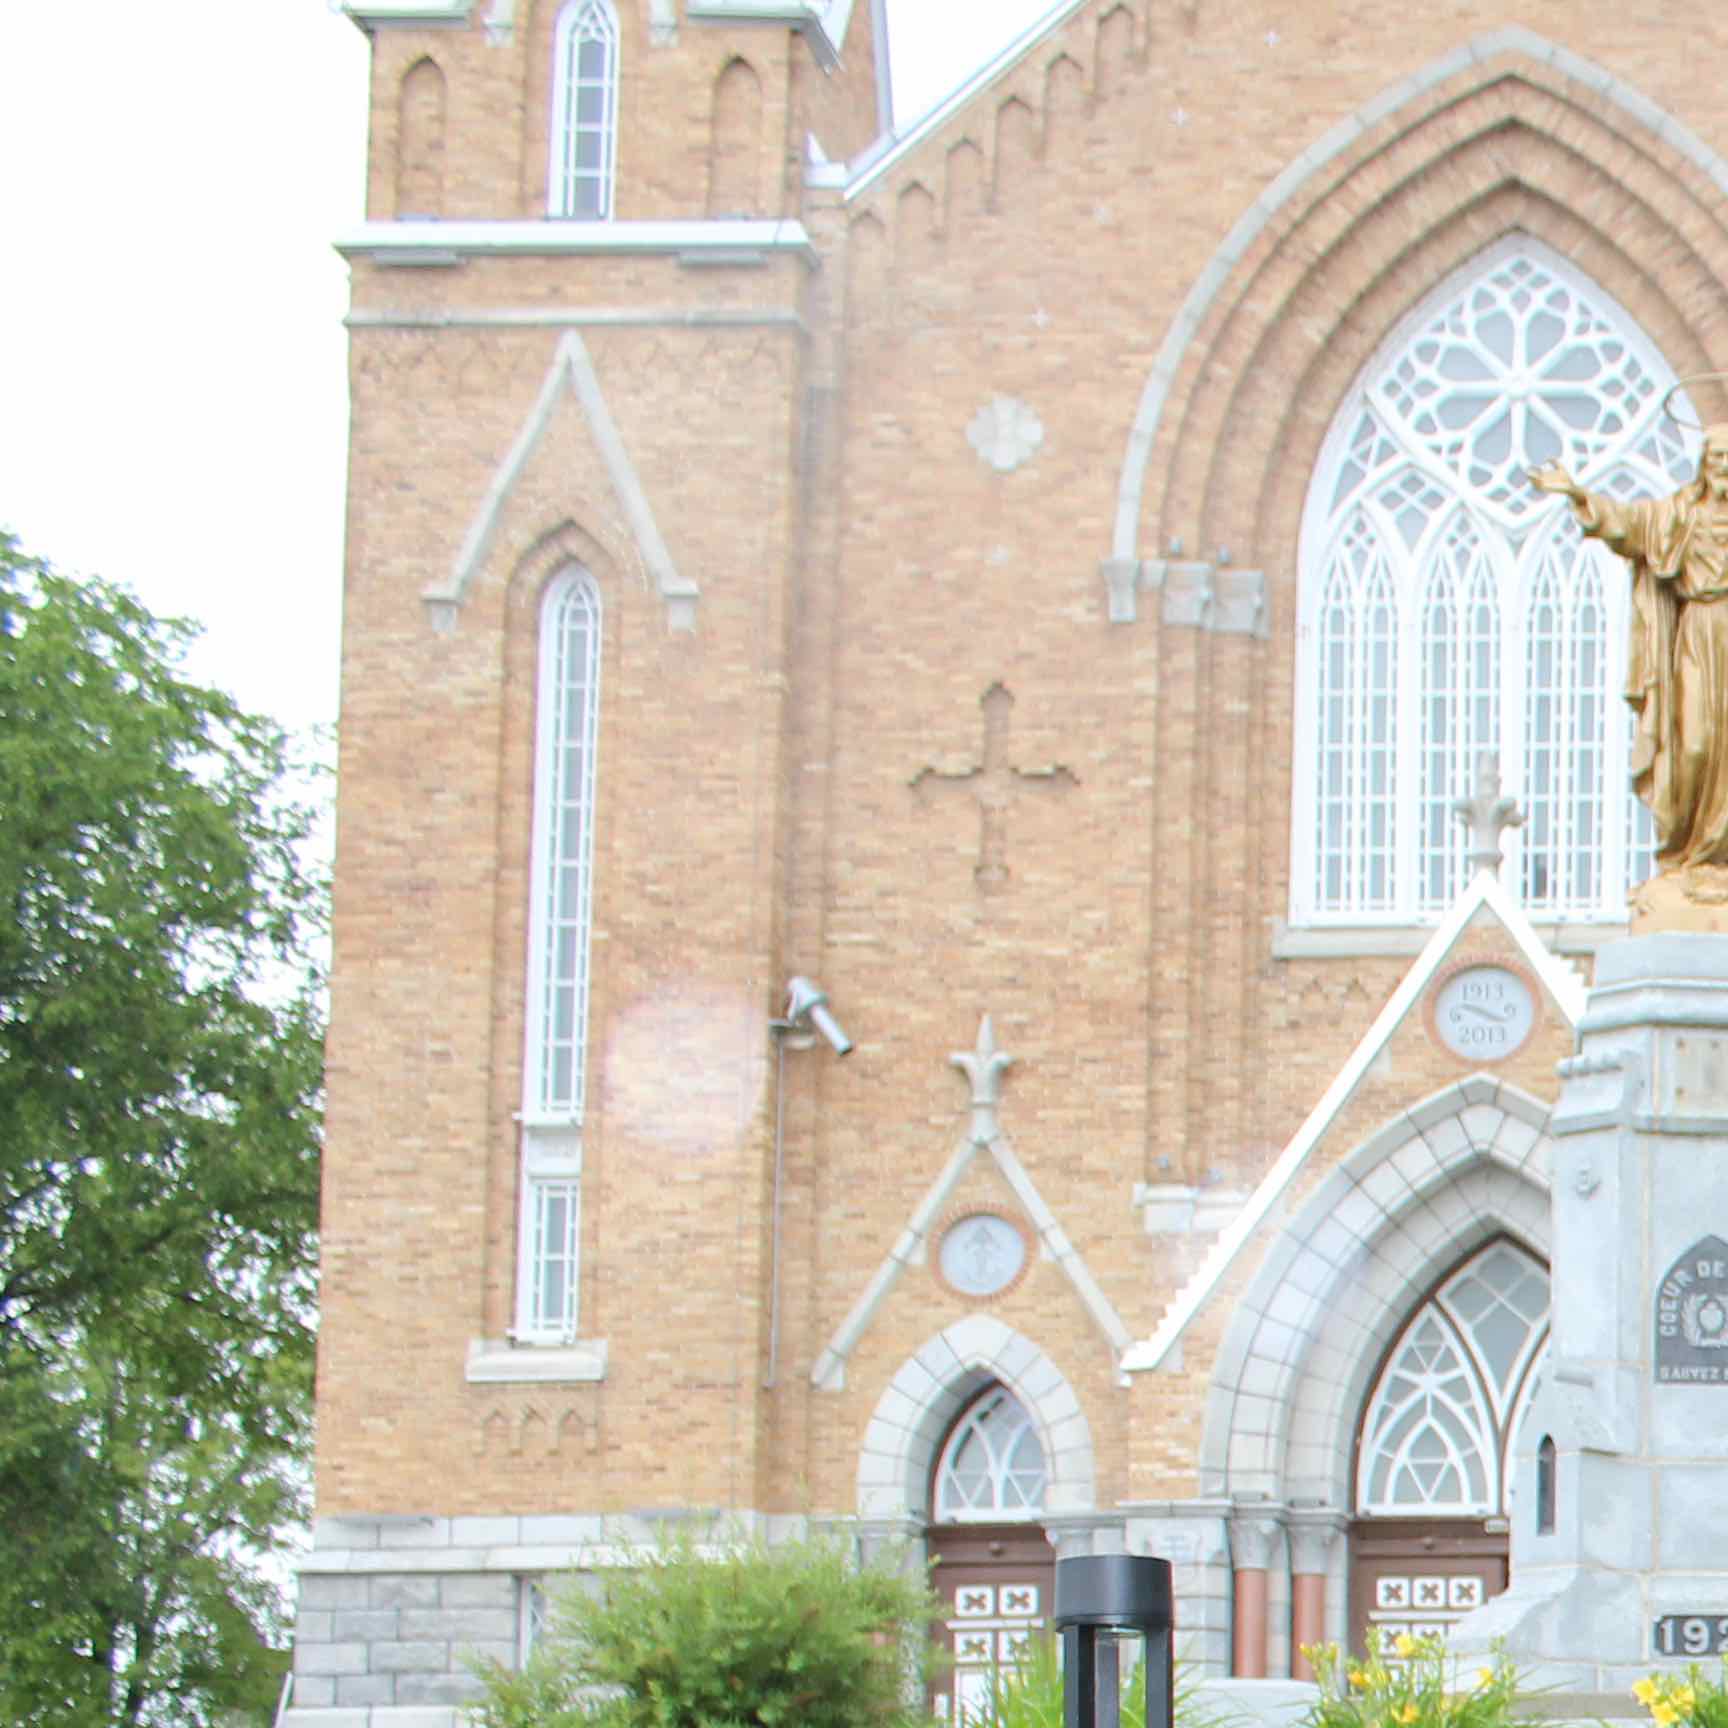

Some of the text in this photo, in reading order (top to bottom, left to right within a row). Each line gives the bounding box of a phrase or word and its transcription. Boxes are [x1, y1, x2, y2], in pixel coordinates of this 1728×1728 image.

[1660, 1269, 1694, 1337] COEUR
[1696, 1259, 1726, 1279] DE
[1660, 1365, 1720, 1381] SAUVEZ
